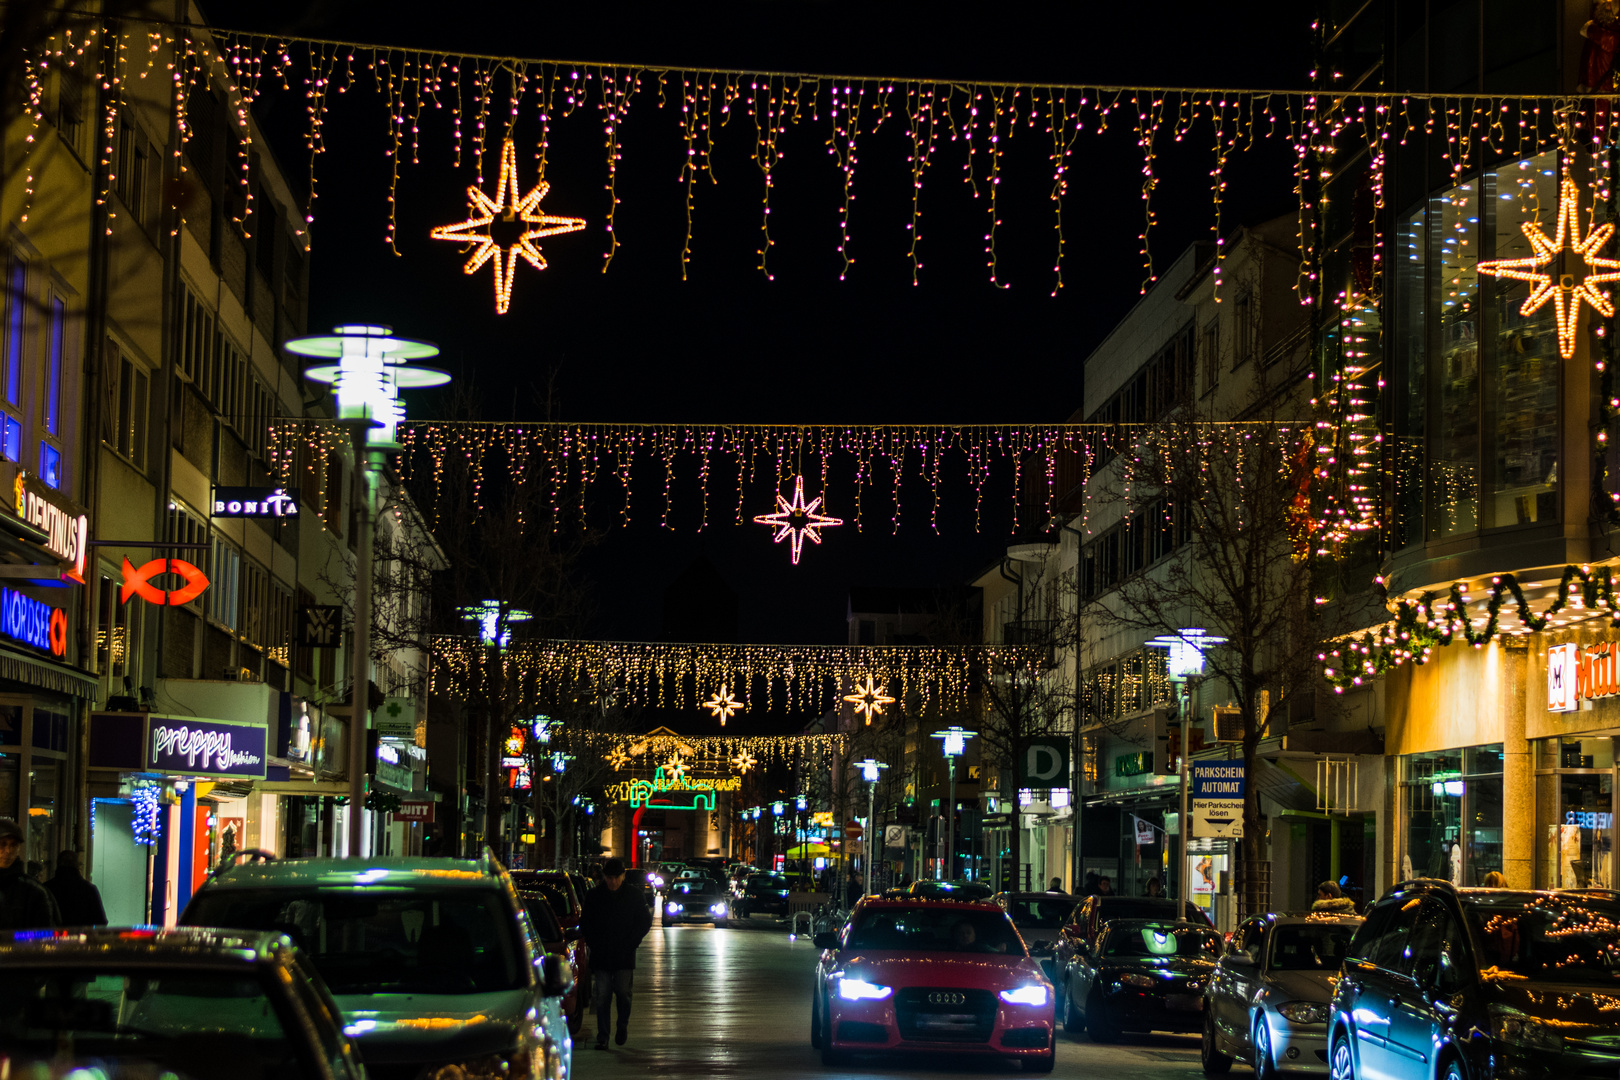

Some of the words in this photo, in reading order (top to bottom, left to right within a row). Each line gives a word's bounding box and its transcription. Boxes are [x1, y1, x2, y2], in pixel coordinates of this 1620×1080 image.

[215, 489, 298, 516] BONITA
[27, 491, 78, 562] DENTINUS
[1, 587, 51, 650] NORDSEE
[1575, 640, 1620, 700] Mül
[152, 725, 231, 770] preppy
[1027, 745, 1062, 781] D
[1194, 767, 1244, 778] PARKSCHEIN
[1201, 782, 1240, 793] AUTOMAT
[400, 804, 429, 816] WITT
